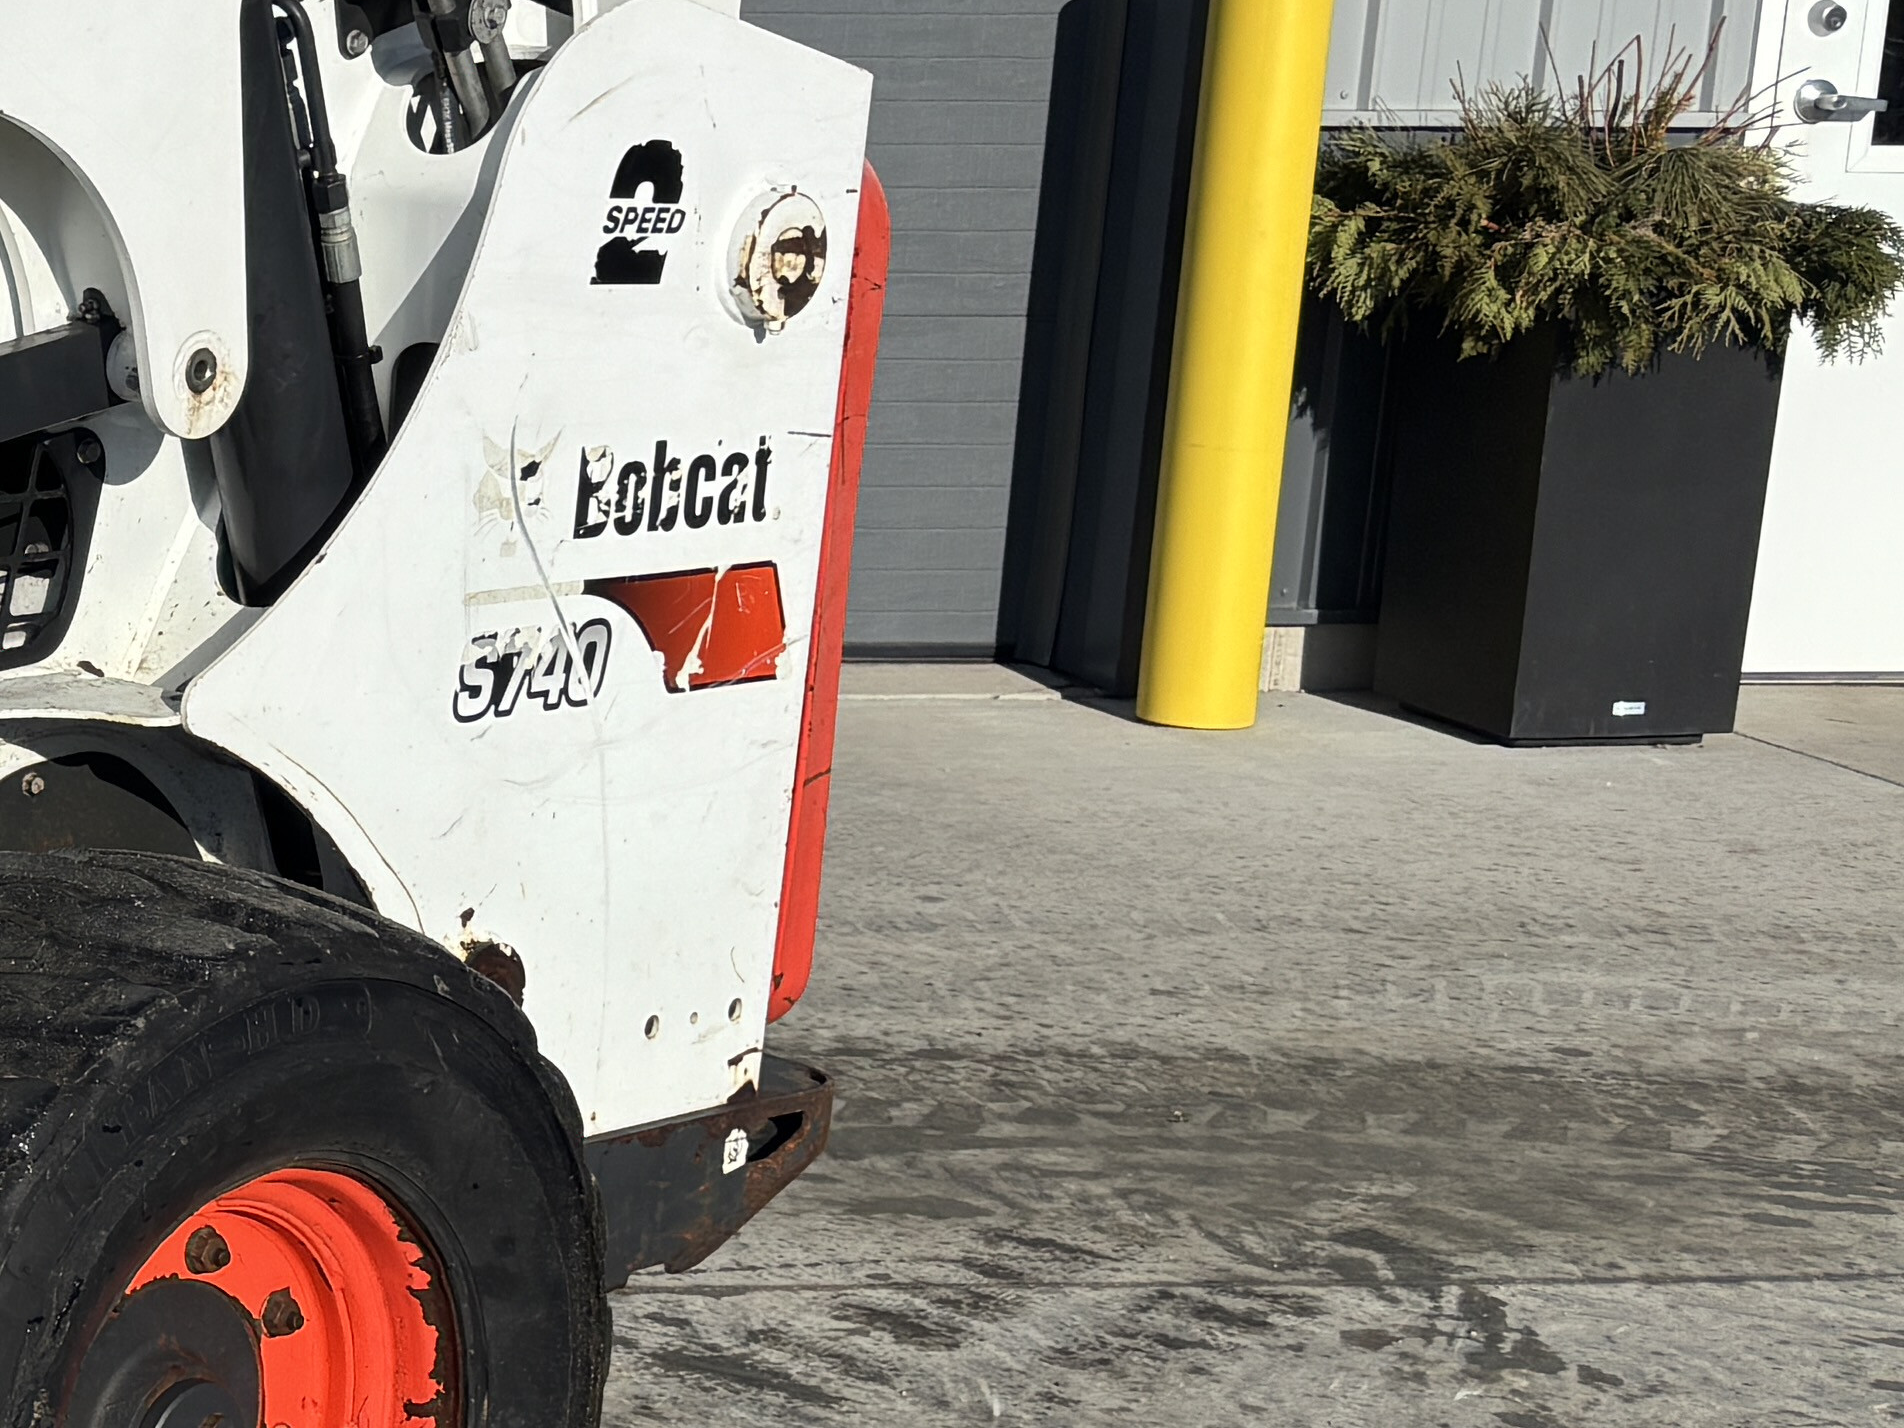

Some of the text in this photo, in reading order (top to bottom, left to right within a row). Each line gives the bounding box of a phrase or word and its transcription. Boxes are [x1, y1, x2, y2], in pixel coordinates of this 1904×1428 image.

[602, 204, 687, 235] SPEED
[573, 434, 774, 540] Bobcat
[452, 617, 612, 724] S740
